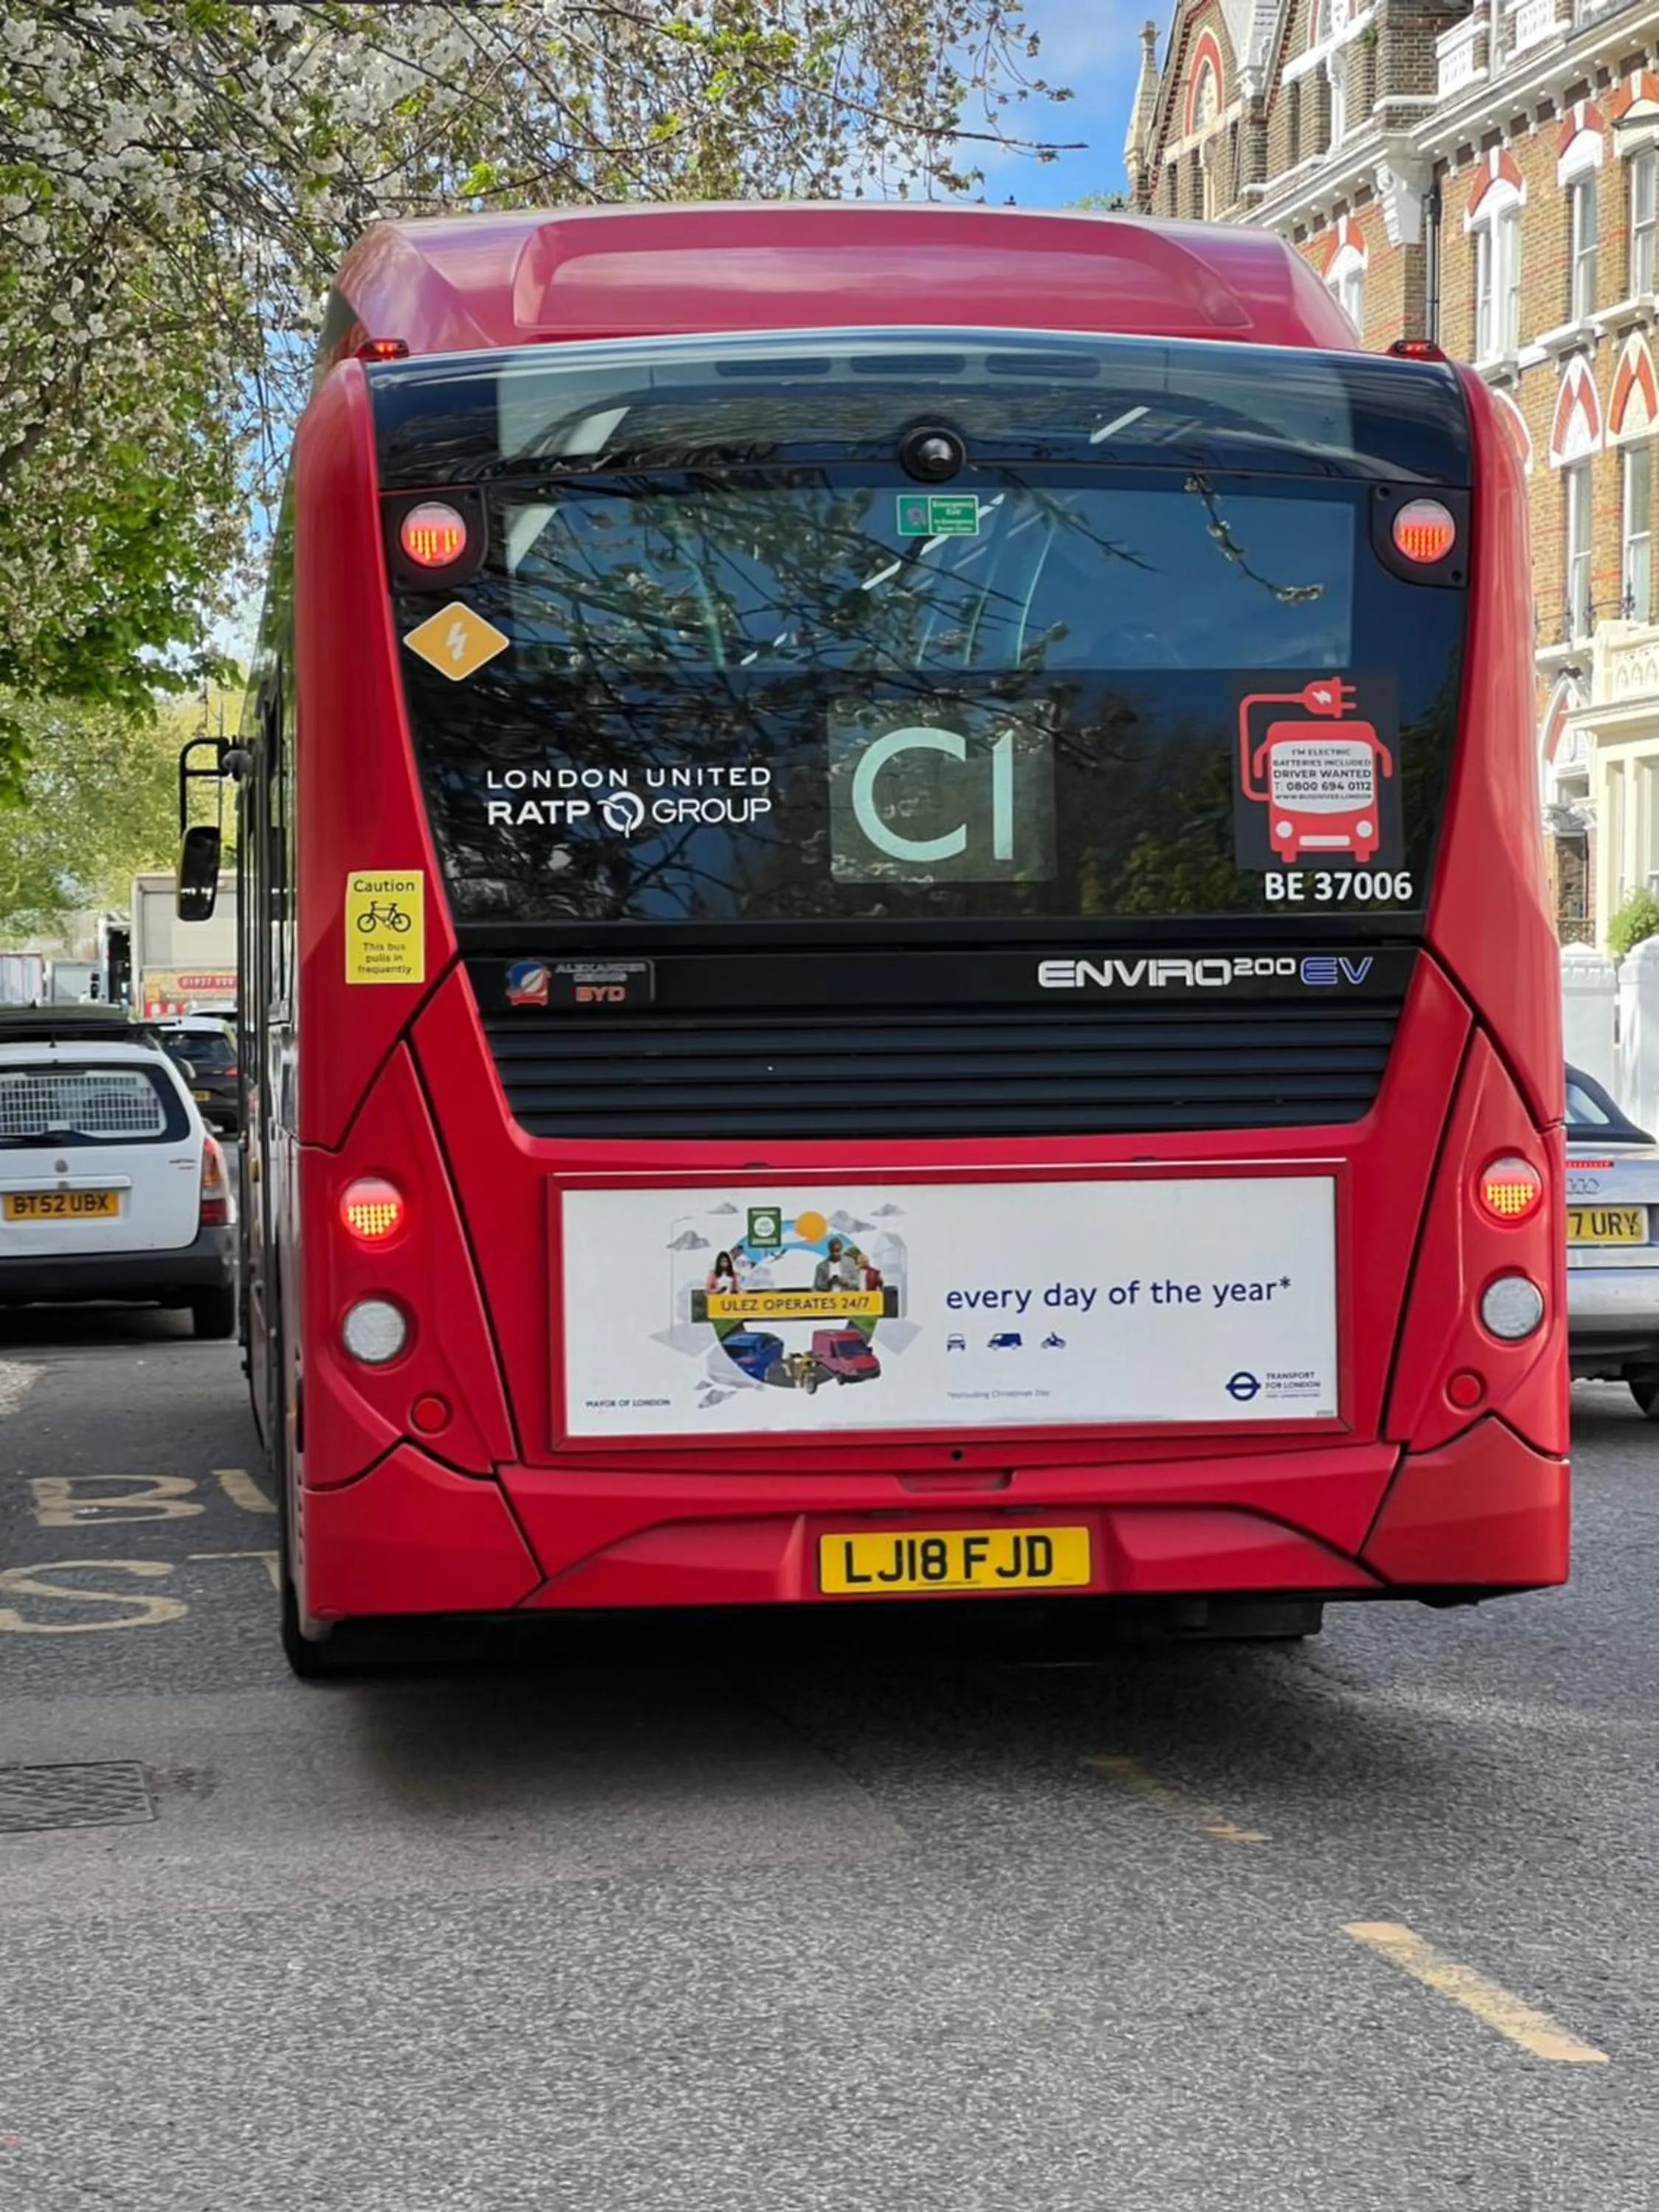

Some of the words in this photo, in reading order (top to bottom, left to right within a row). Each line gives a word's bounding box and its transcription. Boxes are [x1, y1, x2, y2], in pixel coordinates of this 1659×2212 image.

[487, 768, 627, 789] LONDON
[647, 767, 771, 787] UNITED
[1273, 770, 1316, 778] DRIVER
[1320, 770, 1371, 778] WANTED
[1287, 782, 1318, 790] 0800
[1321, 782, 1344, 790] 694
[1348, 782, 1371, 790] 0112
[852, 726, 1014, 862] C1
[487, 799, 591, 825] RATP
[651, 798, 772, 824] GROUP
[353, 880, 415, 892] Caution
[1265, 872, 1304, 900] BE
[1315, 872, 1413, 900] 37006
[363, 942, 384, 950] This
[388, 942, 406, 950] bus
[366, 954, 391, 963] pulls
[358, 965, 412, 975] frequently
[1300, 957, 1374, 985] EV
[575, 986, 625, 1002] BYD
[13, 1194, 66, 1214] BT52
[70, 1193, 108, 1212] UBX
[1591, 1212, 1638, 1236] URY
[946, 1289, 1032, 1314] every
[1043, 1282, 1097, 1312] day
[1108, 1280, 1141, 1304] of
[1150, 1279, 1202, 1304] the
[720, 1299, 759, 1312] ULEZ
[763, 1298, 837, 1311] OPERATES
[841, 1297, 869, 1310] 24/7
[1266, 1371, 1315, 1380] TRANSPORT
[1284, 1381, 1321, 1389] LONDON
[633, 1399, 671, 1407] LONDON
[844, 1538, 947, 1583] LJ18
[963, 1534, 1053, 1580] FJD
